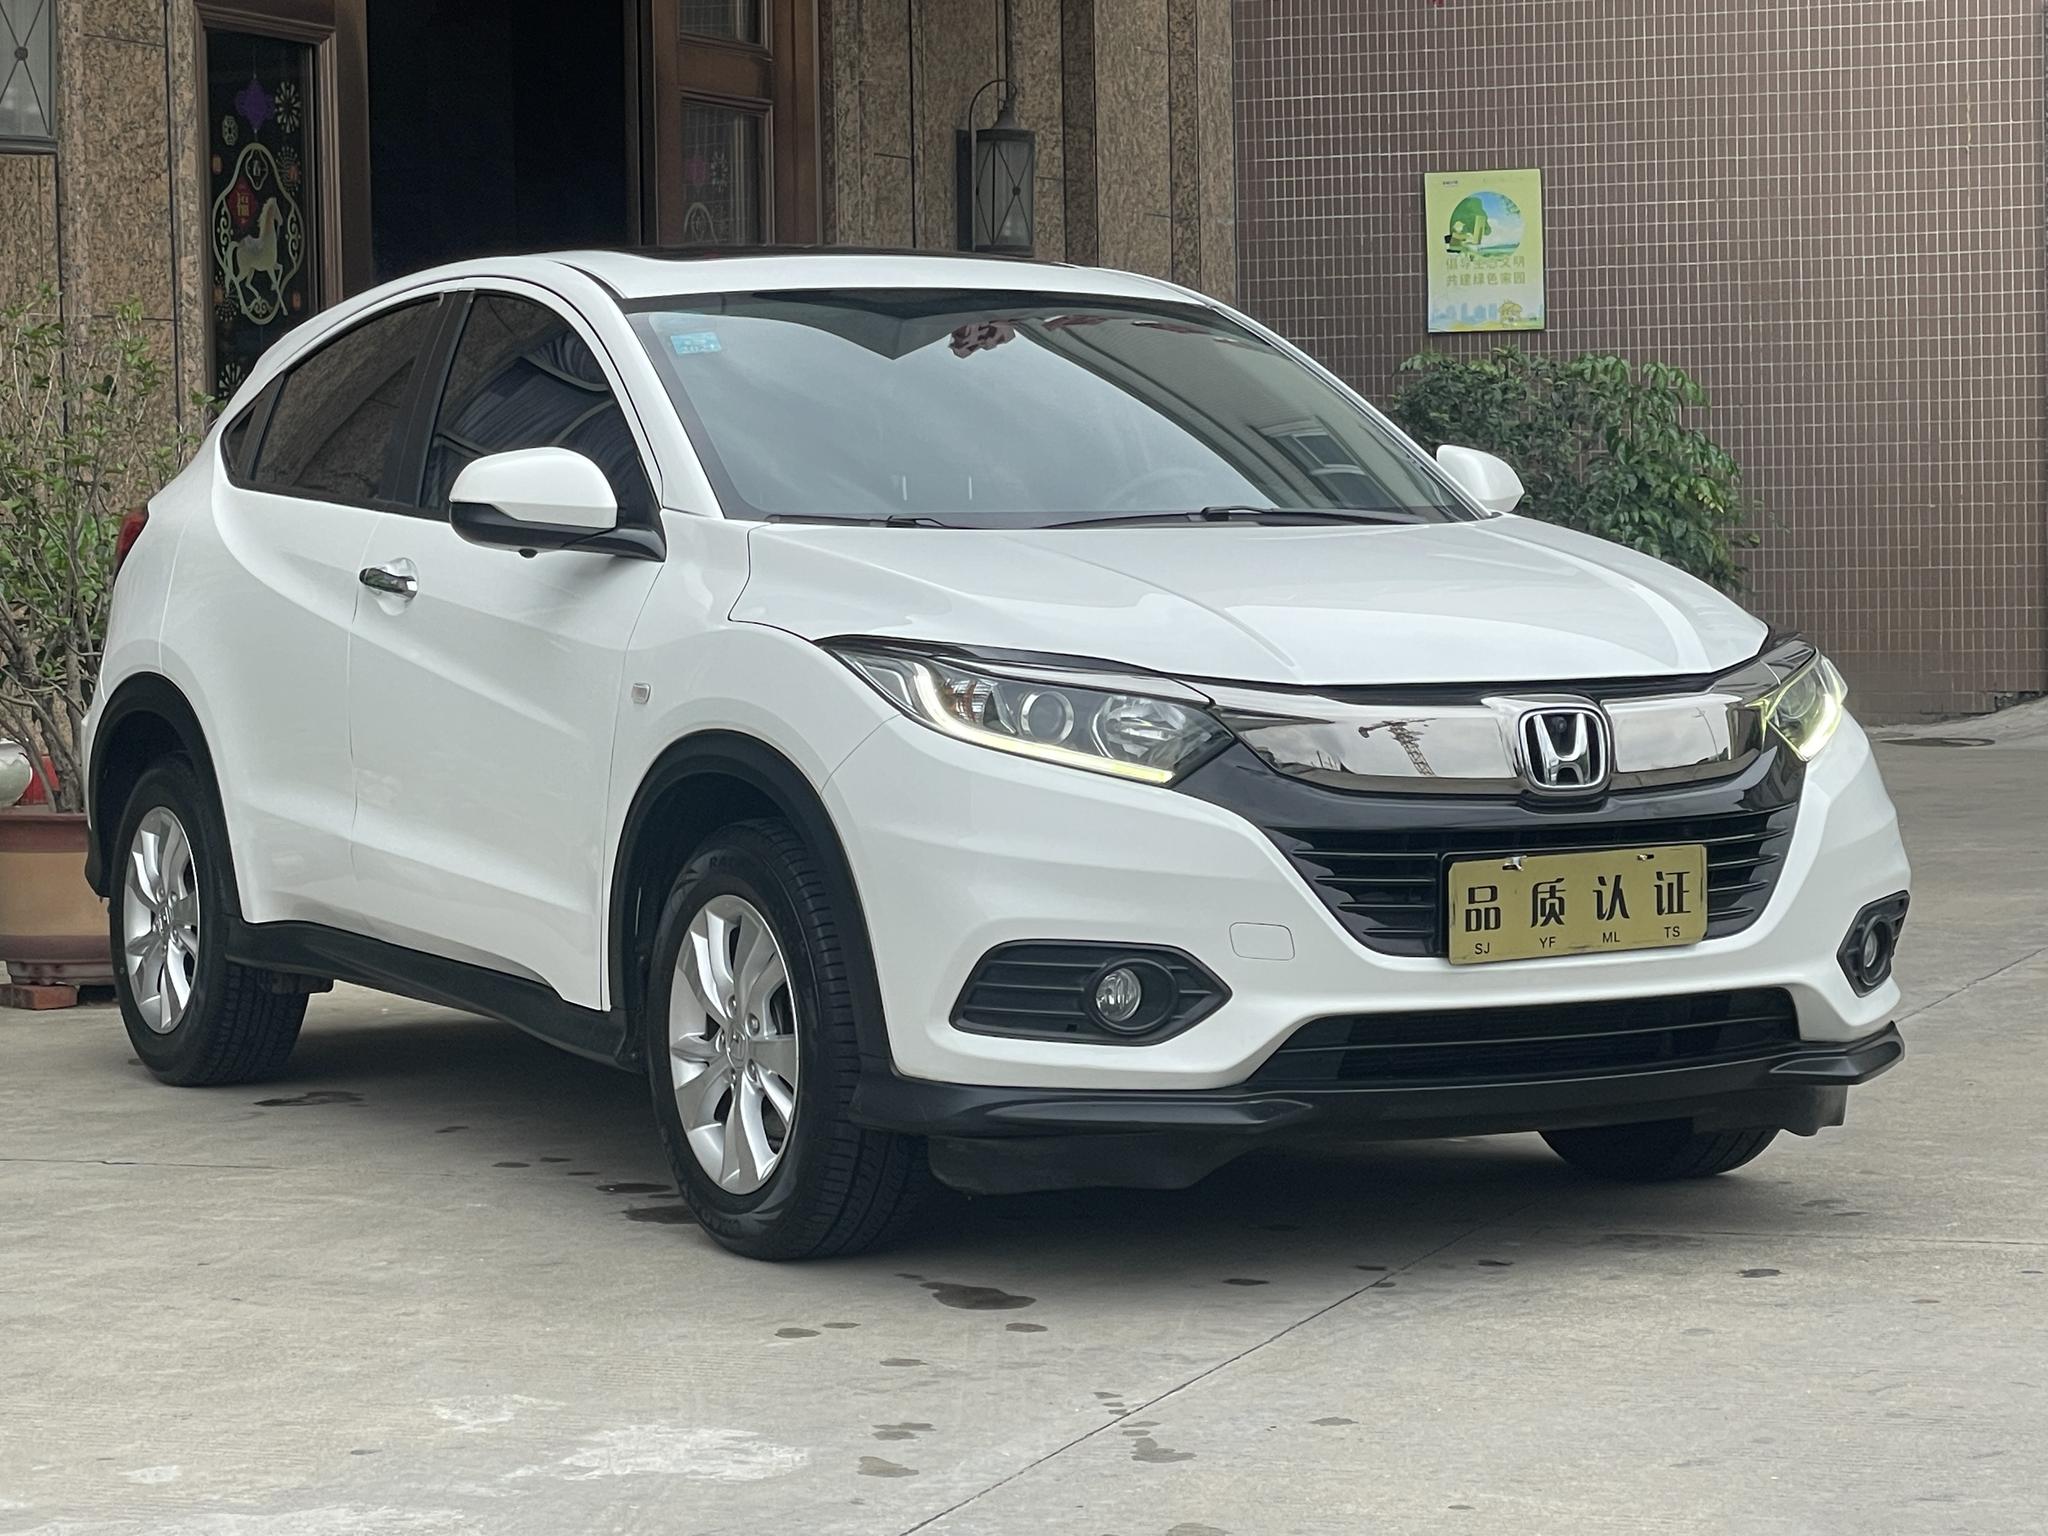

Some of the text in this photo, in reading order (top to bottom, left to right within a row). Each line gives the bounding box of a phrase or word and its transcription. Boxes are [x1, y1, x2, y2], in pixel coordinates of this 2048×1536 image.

[1465, 871, 1691, 932] 品质认证
[1474, 926, 1681, 955] SJ YF ML TS
